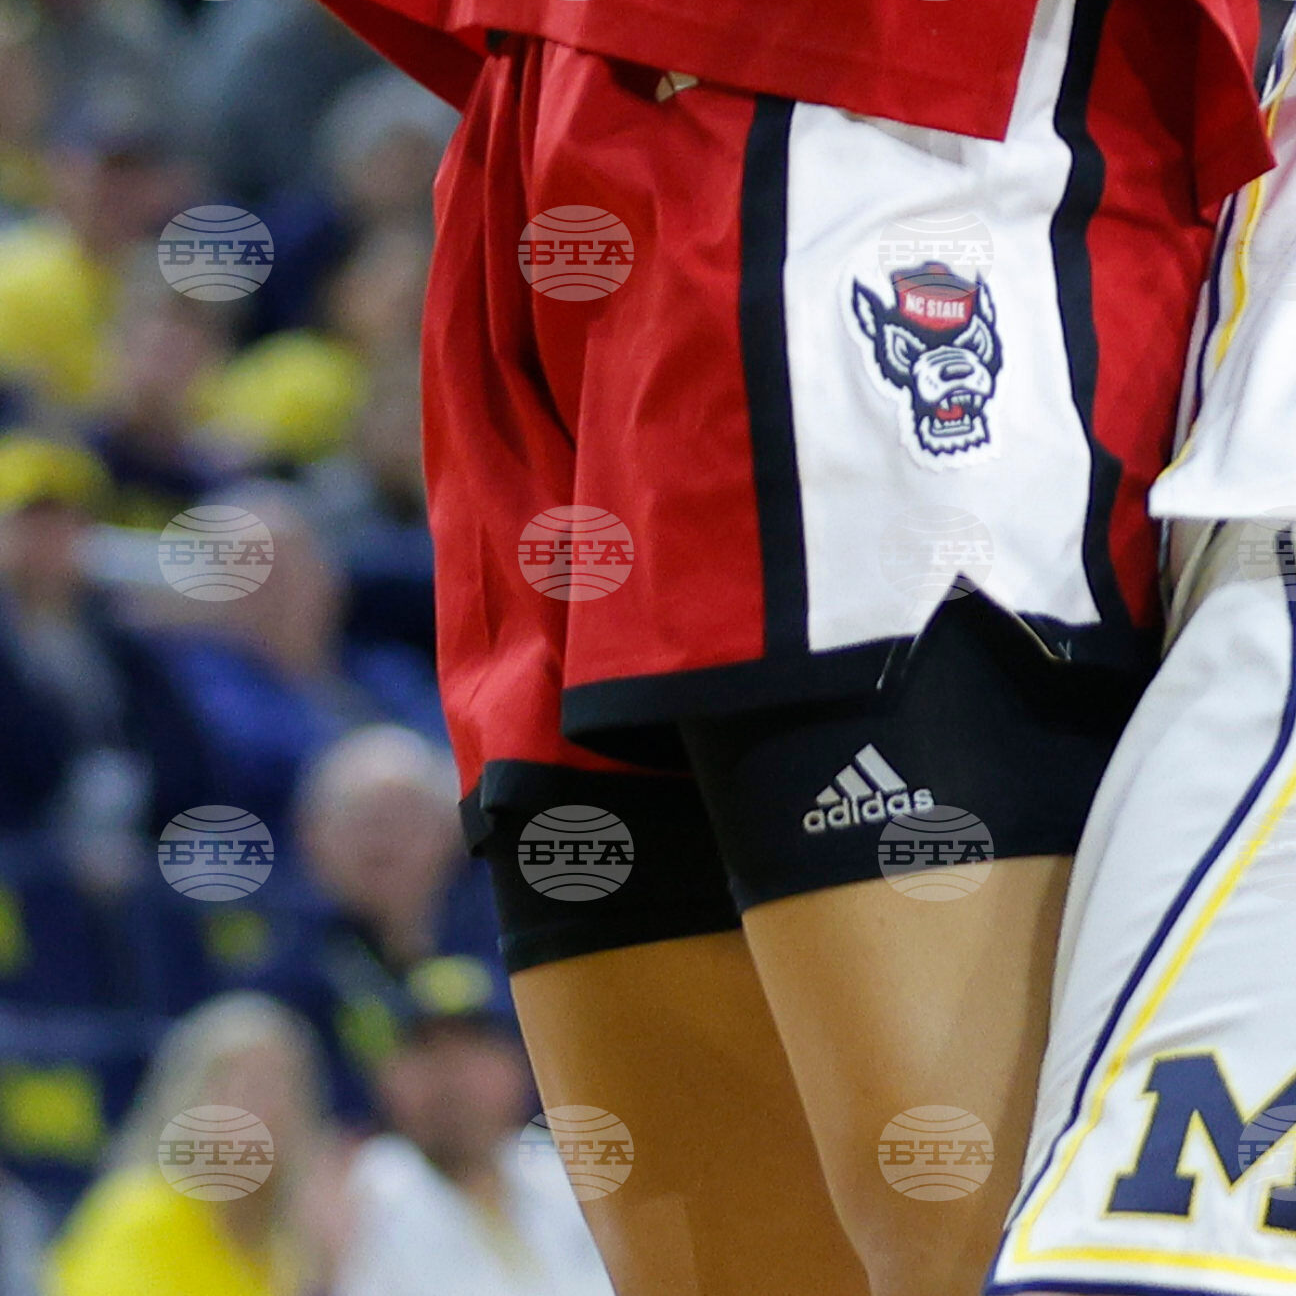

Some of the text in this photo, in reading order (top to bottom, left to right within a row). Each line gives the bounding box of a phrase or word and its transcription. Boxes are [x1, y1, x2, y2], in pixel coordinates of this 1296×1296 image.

[904, 291, 966, 319] NC STATE
[803, 788, 935, 833] adidas
